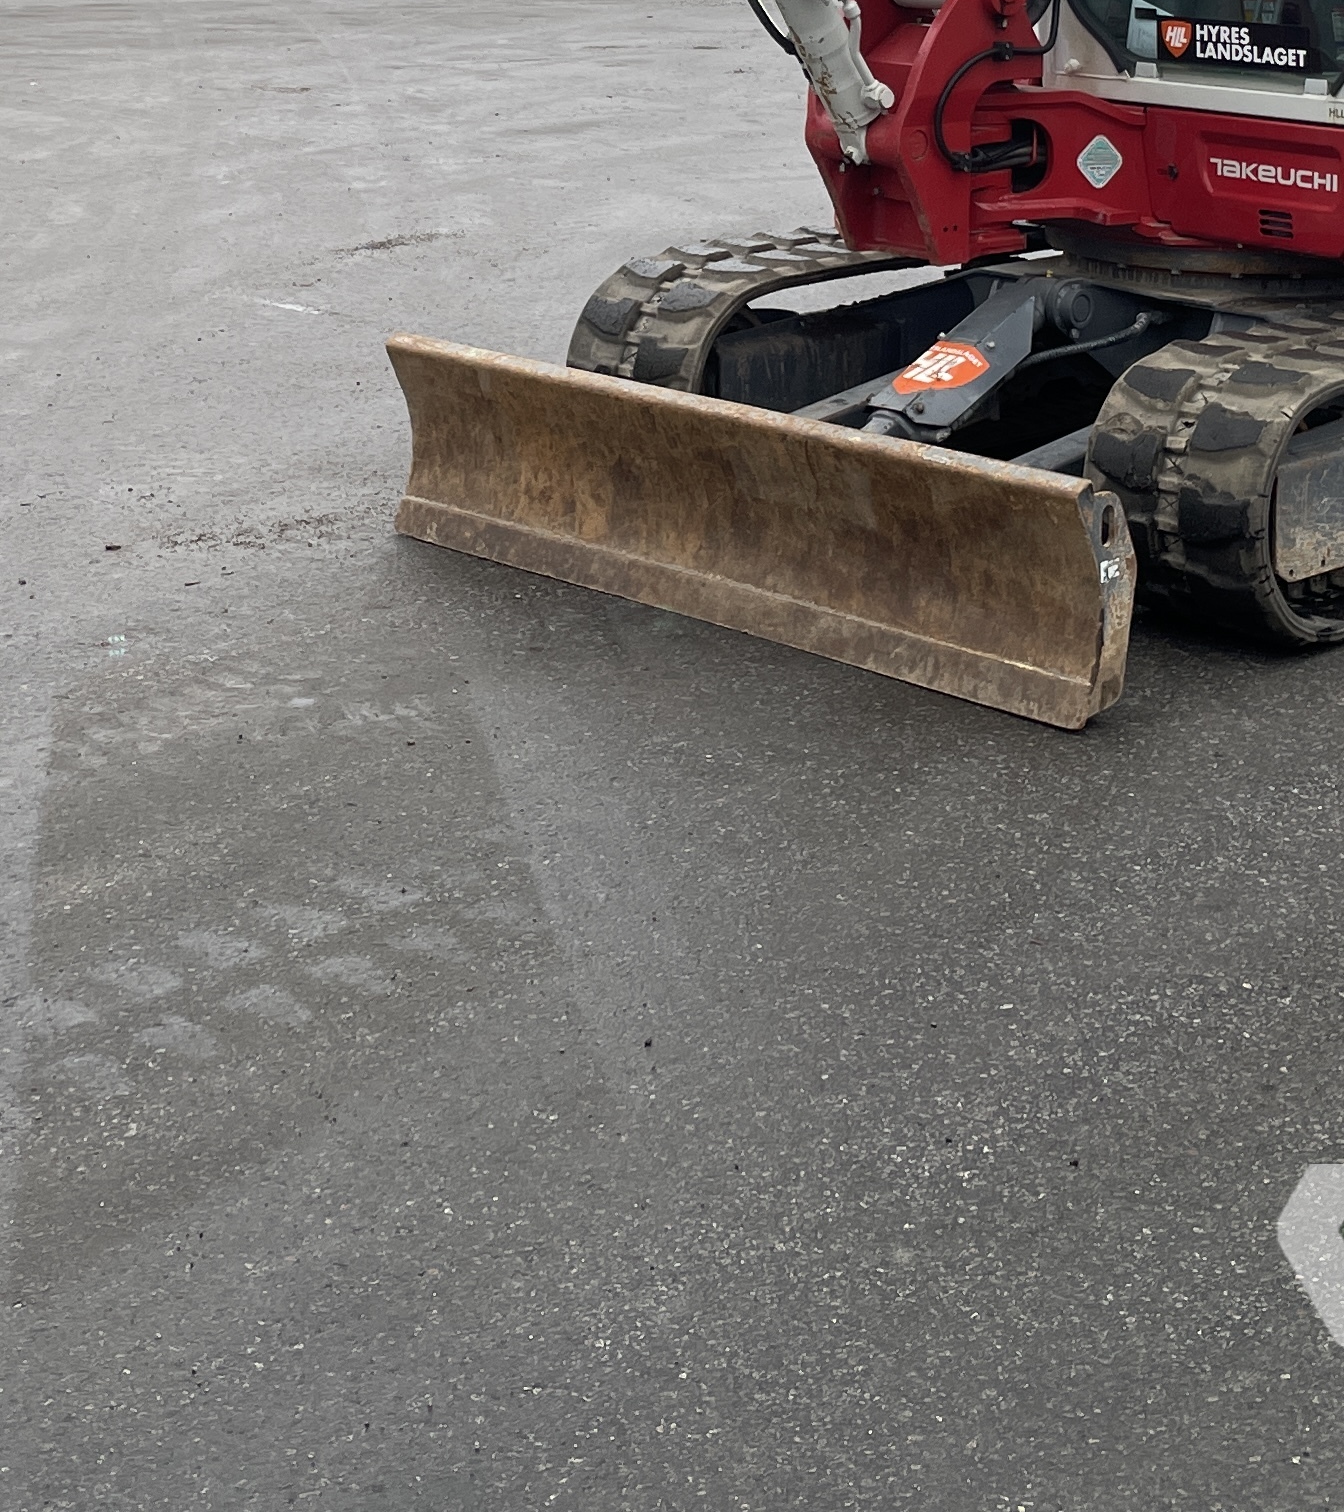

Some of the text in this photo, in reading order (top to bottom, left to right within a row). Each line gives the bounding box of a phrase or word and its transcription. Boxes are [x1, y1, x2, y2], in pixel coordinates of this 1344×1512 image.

[1195, 23, 1250, 45] HYRES
[1196, 41, 1307, 68] LANDSLAGET
[1209, 157, 1339, 193] TAKEUCHI
